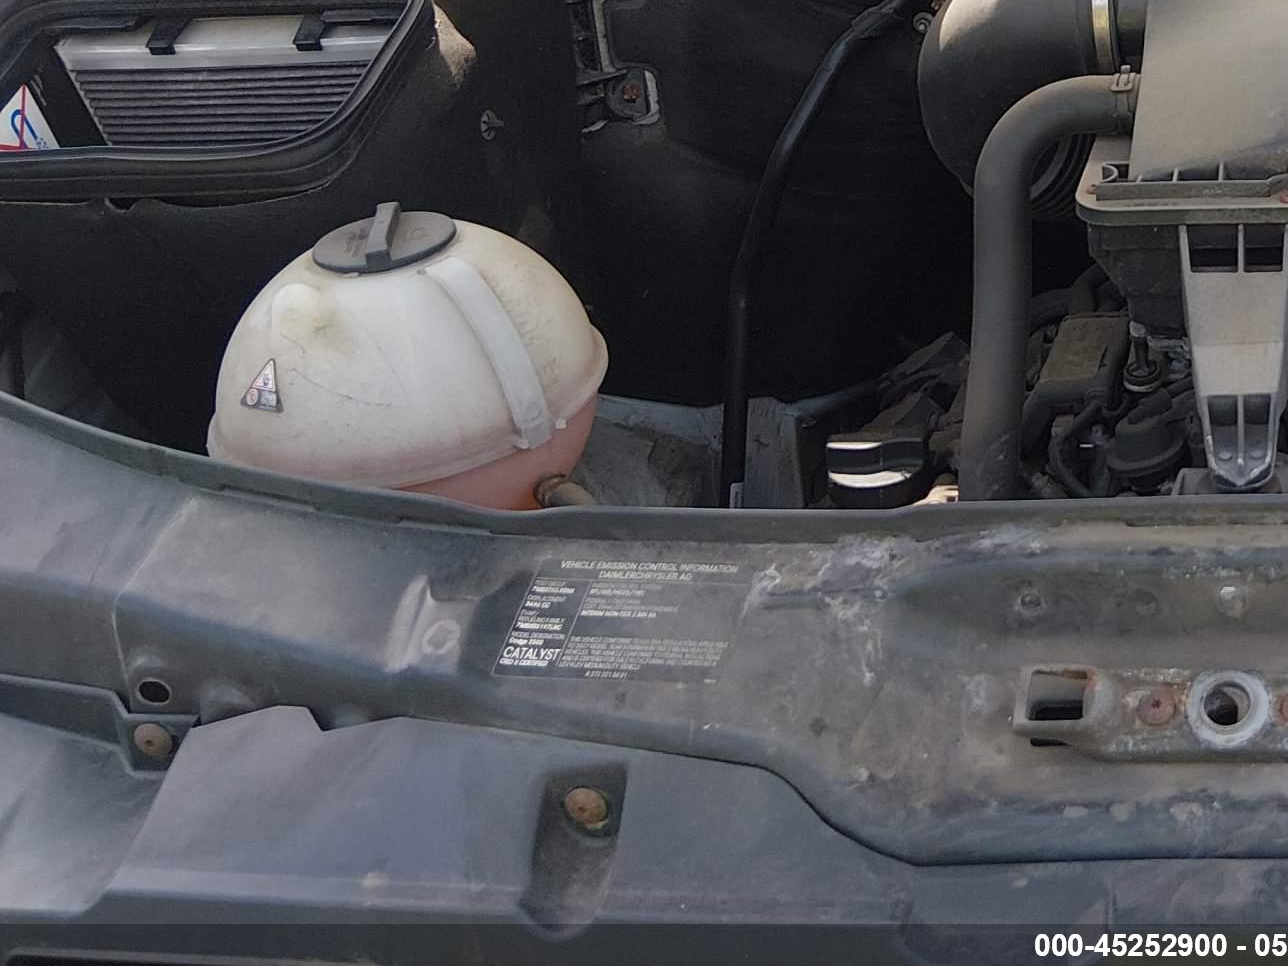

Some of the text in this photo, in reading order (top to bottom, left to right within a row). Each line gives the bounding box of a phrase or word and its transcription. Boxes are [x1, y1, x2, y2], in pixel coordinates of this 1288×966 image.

[561, 560, 738, 572] VEHICLE EMISSION CONTROL INFORMATION
[599, 570, 679, 580] DAIMLERCHRYSLER
[502, 647, 560, 659] CATALYST
